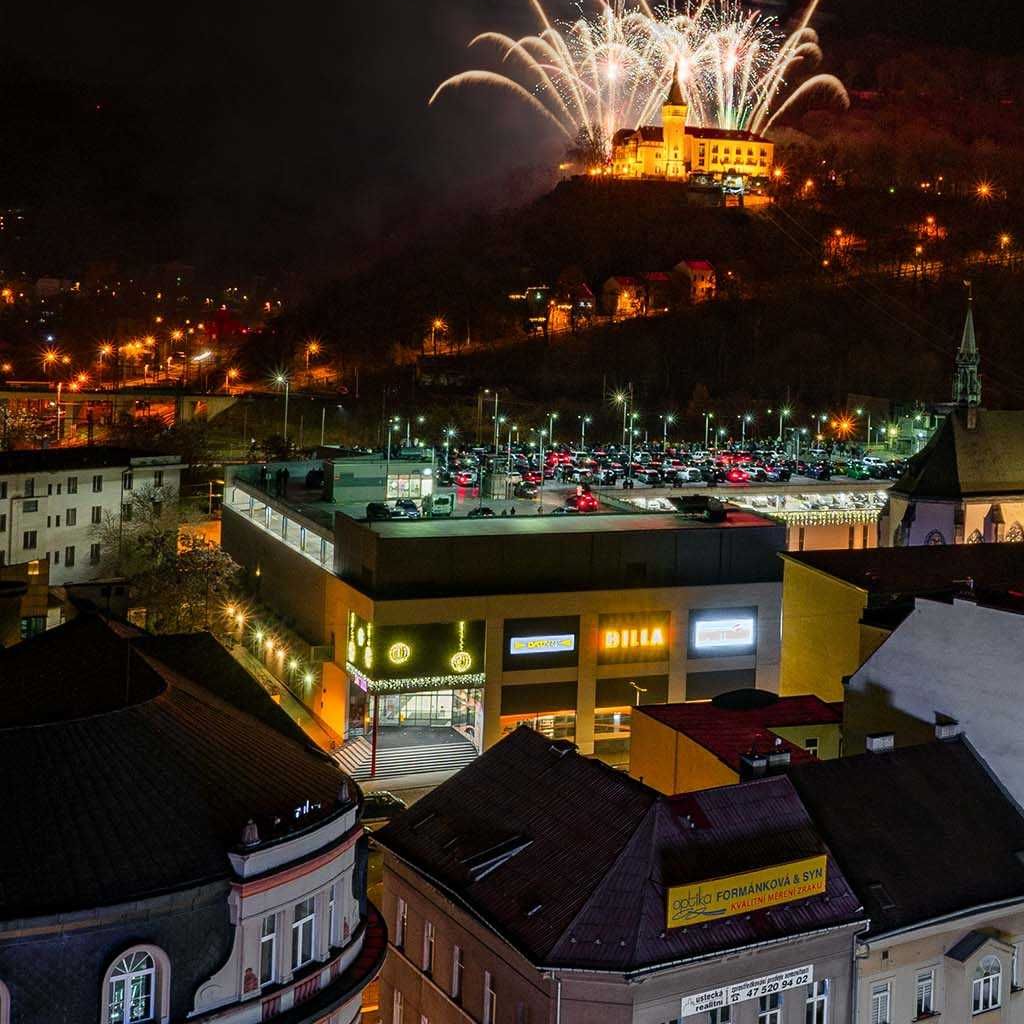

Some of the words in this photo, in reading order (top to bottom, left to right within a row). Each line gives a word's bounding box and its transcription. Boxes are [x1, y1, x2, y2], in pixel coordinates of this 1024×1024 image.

[605, 628, 664, 649] BILLA
[672, 888, 712, 912] optika
[716, 873, 790, 902] FORMÁNKOVÁ
[793, 875, 801, 885] &
[802, 868, 823, 882] SYN
[746, 987, 759, 997] 47
[761, 982, 779, 994] 520
[782, 979, 793, 989] 94
[796, 974, 808, 984] 02
